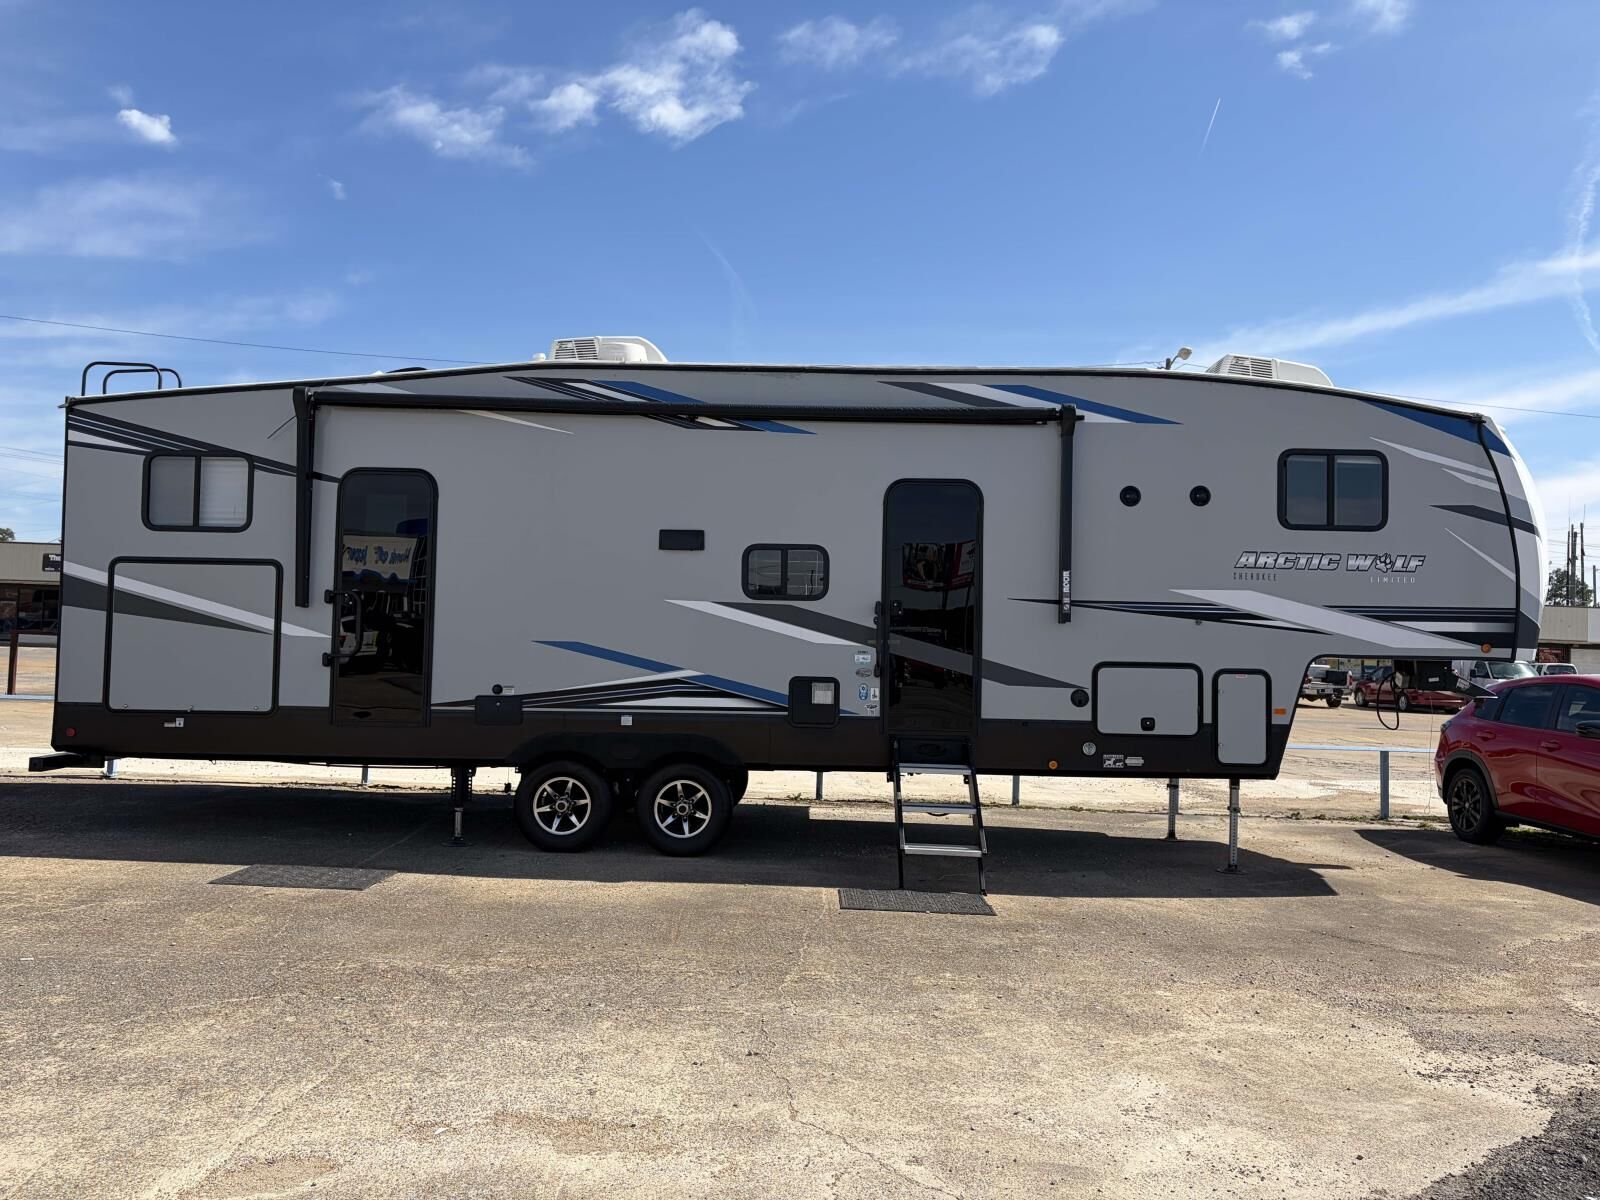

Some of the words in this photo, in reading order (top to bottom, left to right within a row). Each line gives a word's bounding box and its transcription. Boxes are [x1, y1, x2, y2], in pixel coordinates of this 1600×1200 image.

[1234, 551, 1341, 571] ARCTIC
[1233, 572, 1277, 582] CHEROKEE
[1370, 576, 1416, 584] LIMITED
